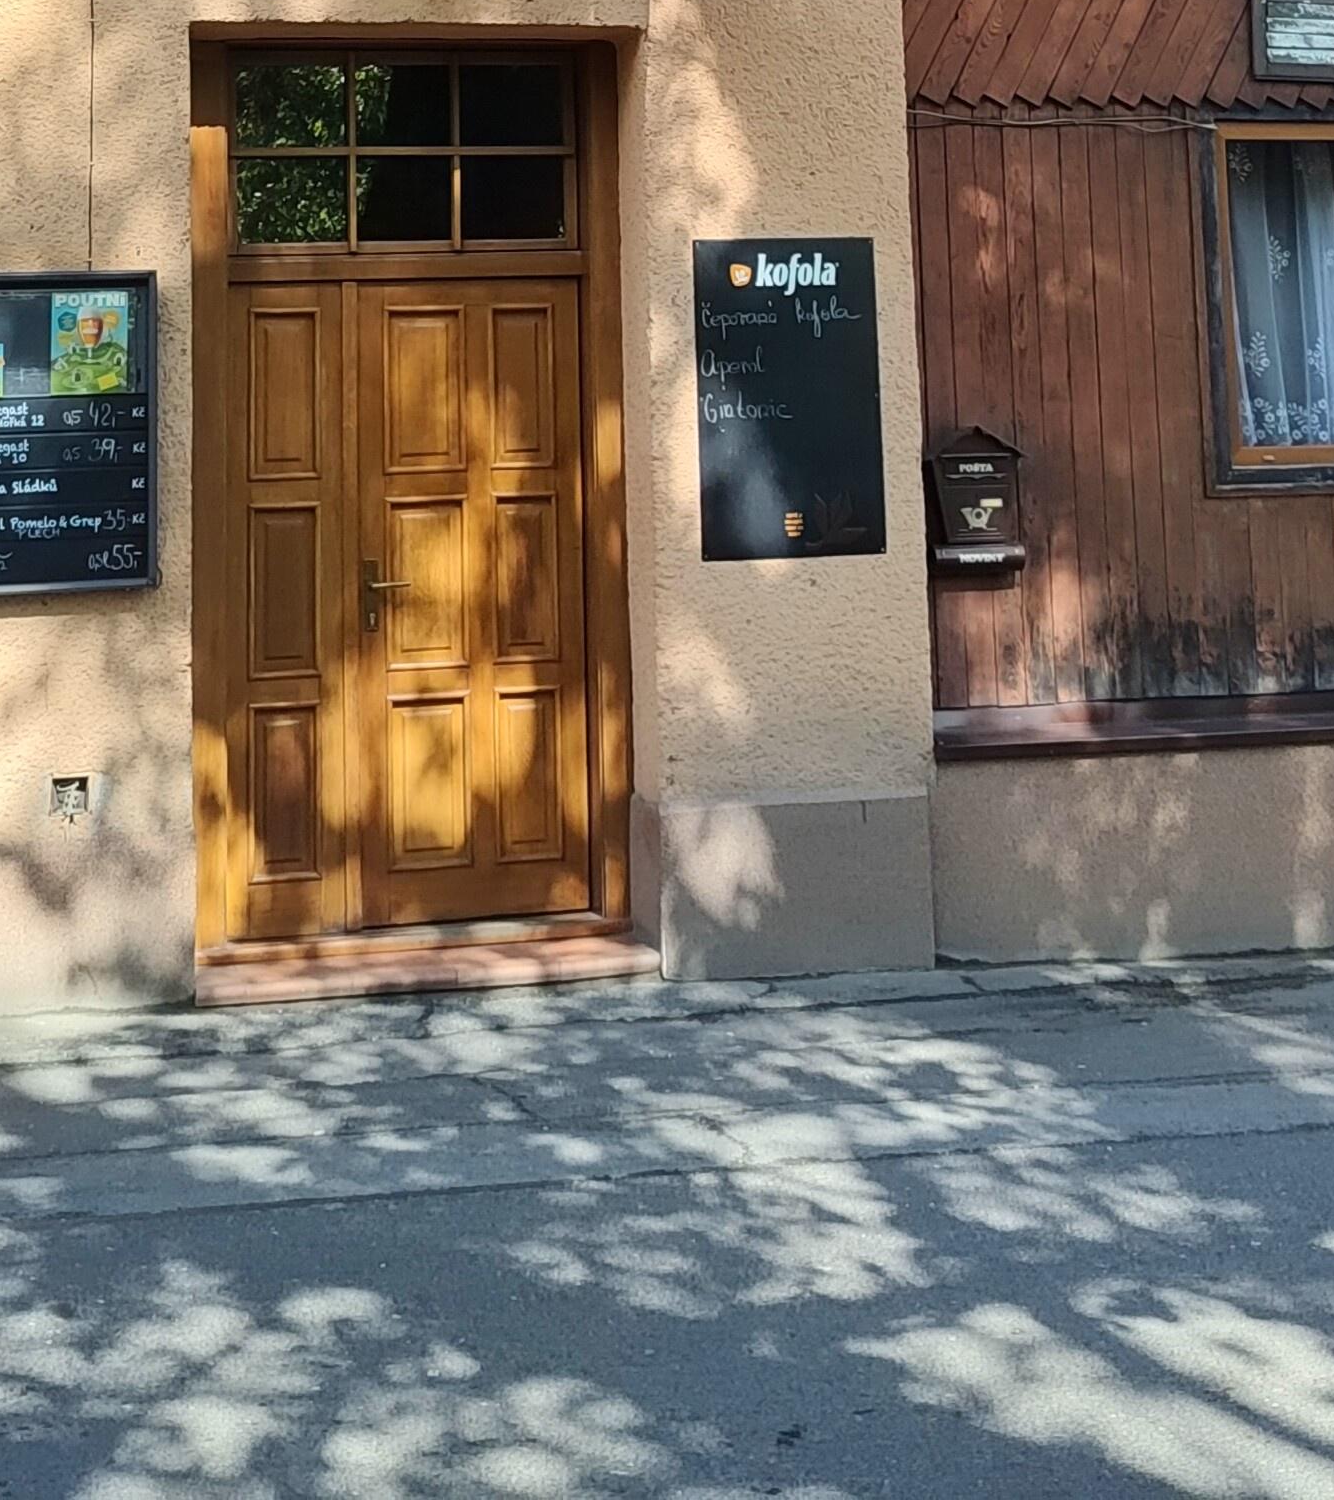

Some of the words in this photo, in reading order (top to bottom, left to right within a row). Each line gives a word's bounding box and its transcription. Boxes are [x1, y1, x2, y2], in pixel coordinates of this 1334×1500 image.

[755, 253, 837, 296] kofola
[795, 295, 862, 338] kofola
[132, 406, 145, 417] Kč
[31, 415, 45, 426] 12
[133, 442, 146, 453] Kč
[12, 453, 27, 464] 10
[959, 462, 994, 473] POŠTA
[12, 478, 58, 494] Sládků
[132, 477, 145, 489] Kč
[10, 515, 57, 530] Pomelo
[59, 515, 67, 528] &
[69, 514, 102, 533] Grep
[132, 512, 146, 524] Kč
[958, 553, 1006, 564] NOVINY
